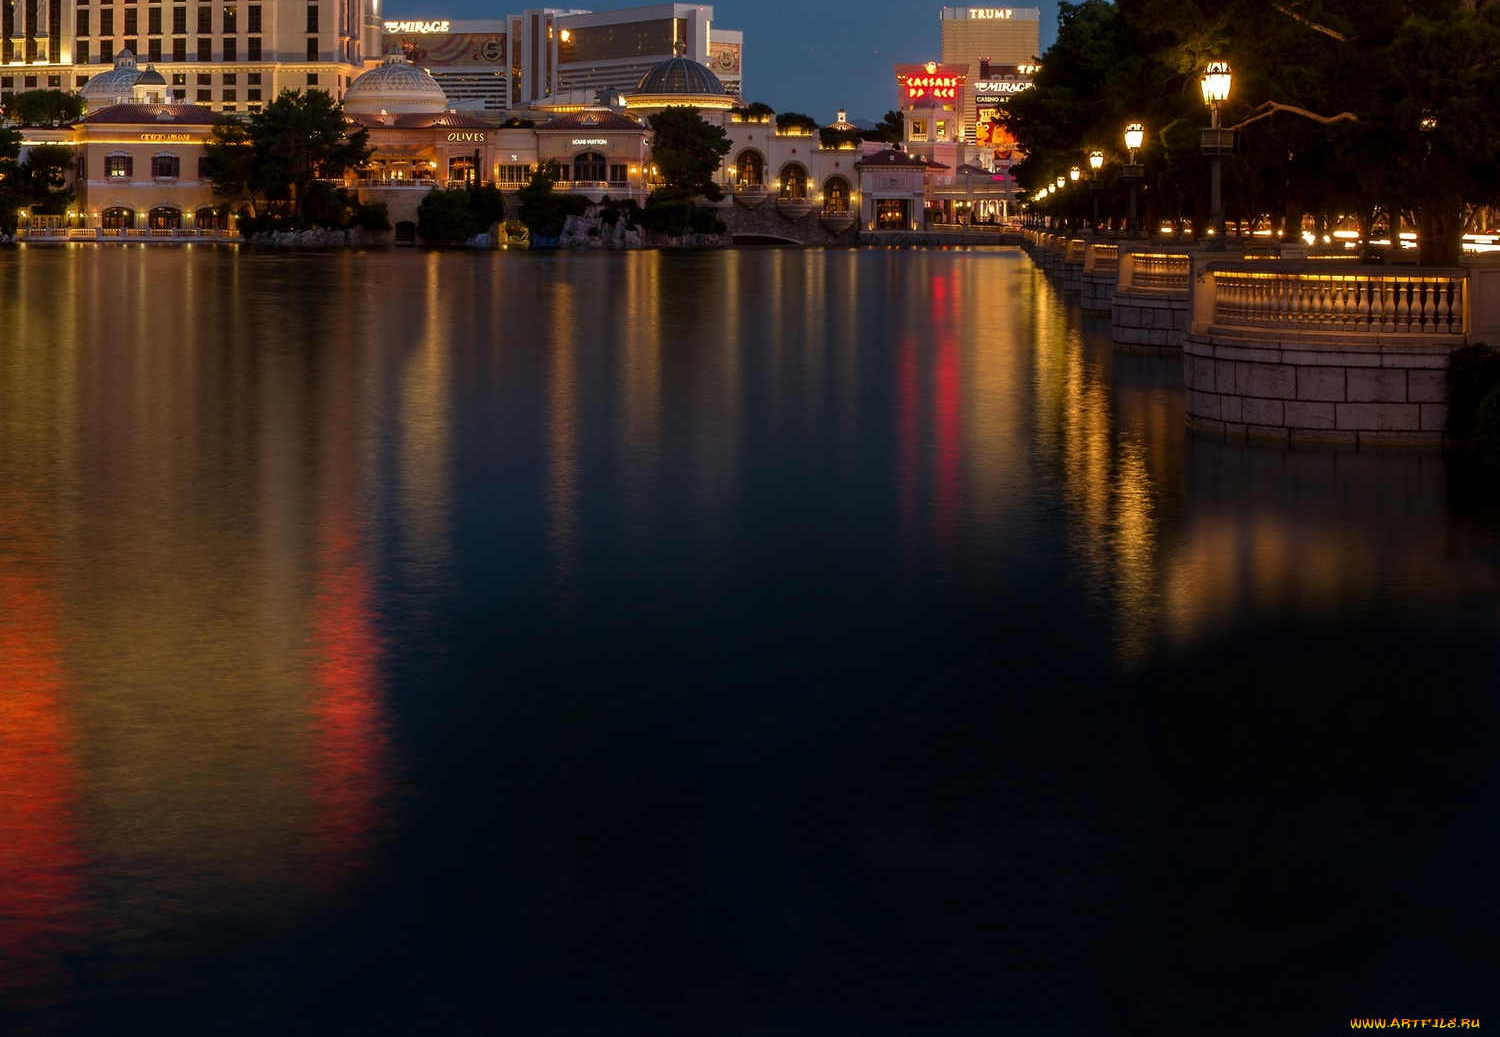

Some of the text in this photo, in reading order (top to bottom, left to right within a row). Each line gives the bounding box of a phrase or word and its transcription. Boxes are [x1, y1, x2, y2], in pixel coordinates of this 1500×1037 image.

[969, 9, 1013, 19] TRUMP
[389, 21, 450, 34] MIRAGE
[906, 77, 958, 88] CAESARS
[909, 88, 955, 98] PAACE
[447, 132, 485, 142] OLIVES
